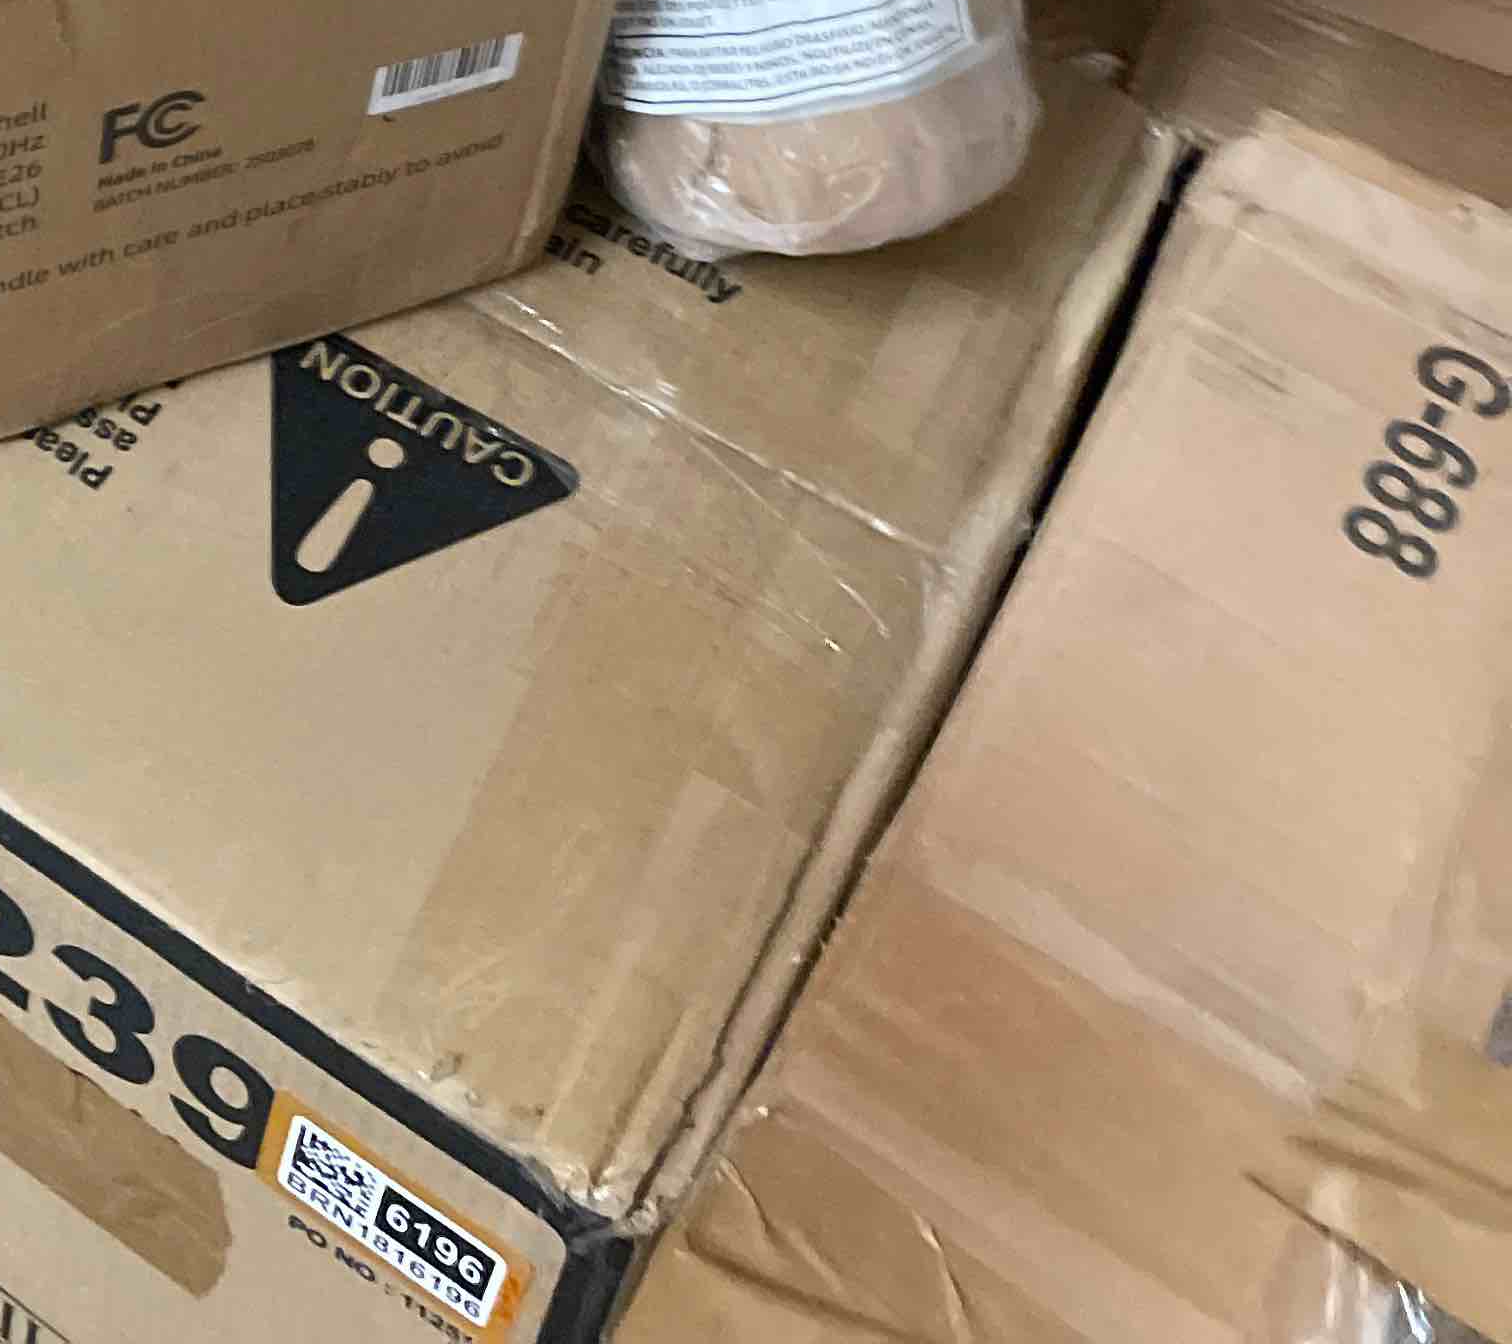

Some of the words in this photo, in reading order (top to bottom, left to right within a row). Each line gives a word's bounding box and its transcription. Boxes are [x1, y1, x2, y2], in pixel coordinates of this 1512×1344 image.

[58, 246, 115, 276] with
[122, 228, 179, 258] care
[187, 207, 238, 239] and
[404, 158, 431, 177] to
[300, 339, 535, 489] CAUTION
[1342, 345, 1512, 580] G-688
[287, 1172, 481, 1319] BRN1816196
[386, 1204, 484, 1285] 6196
